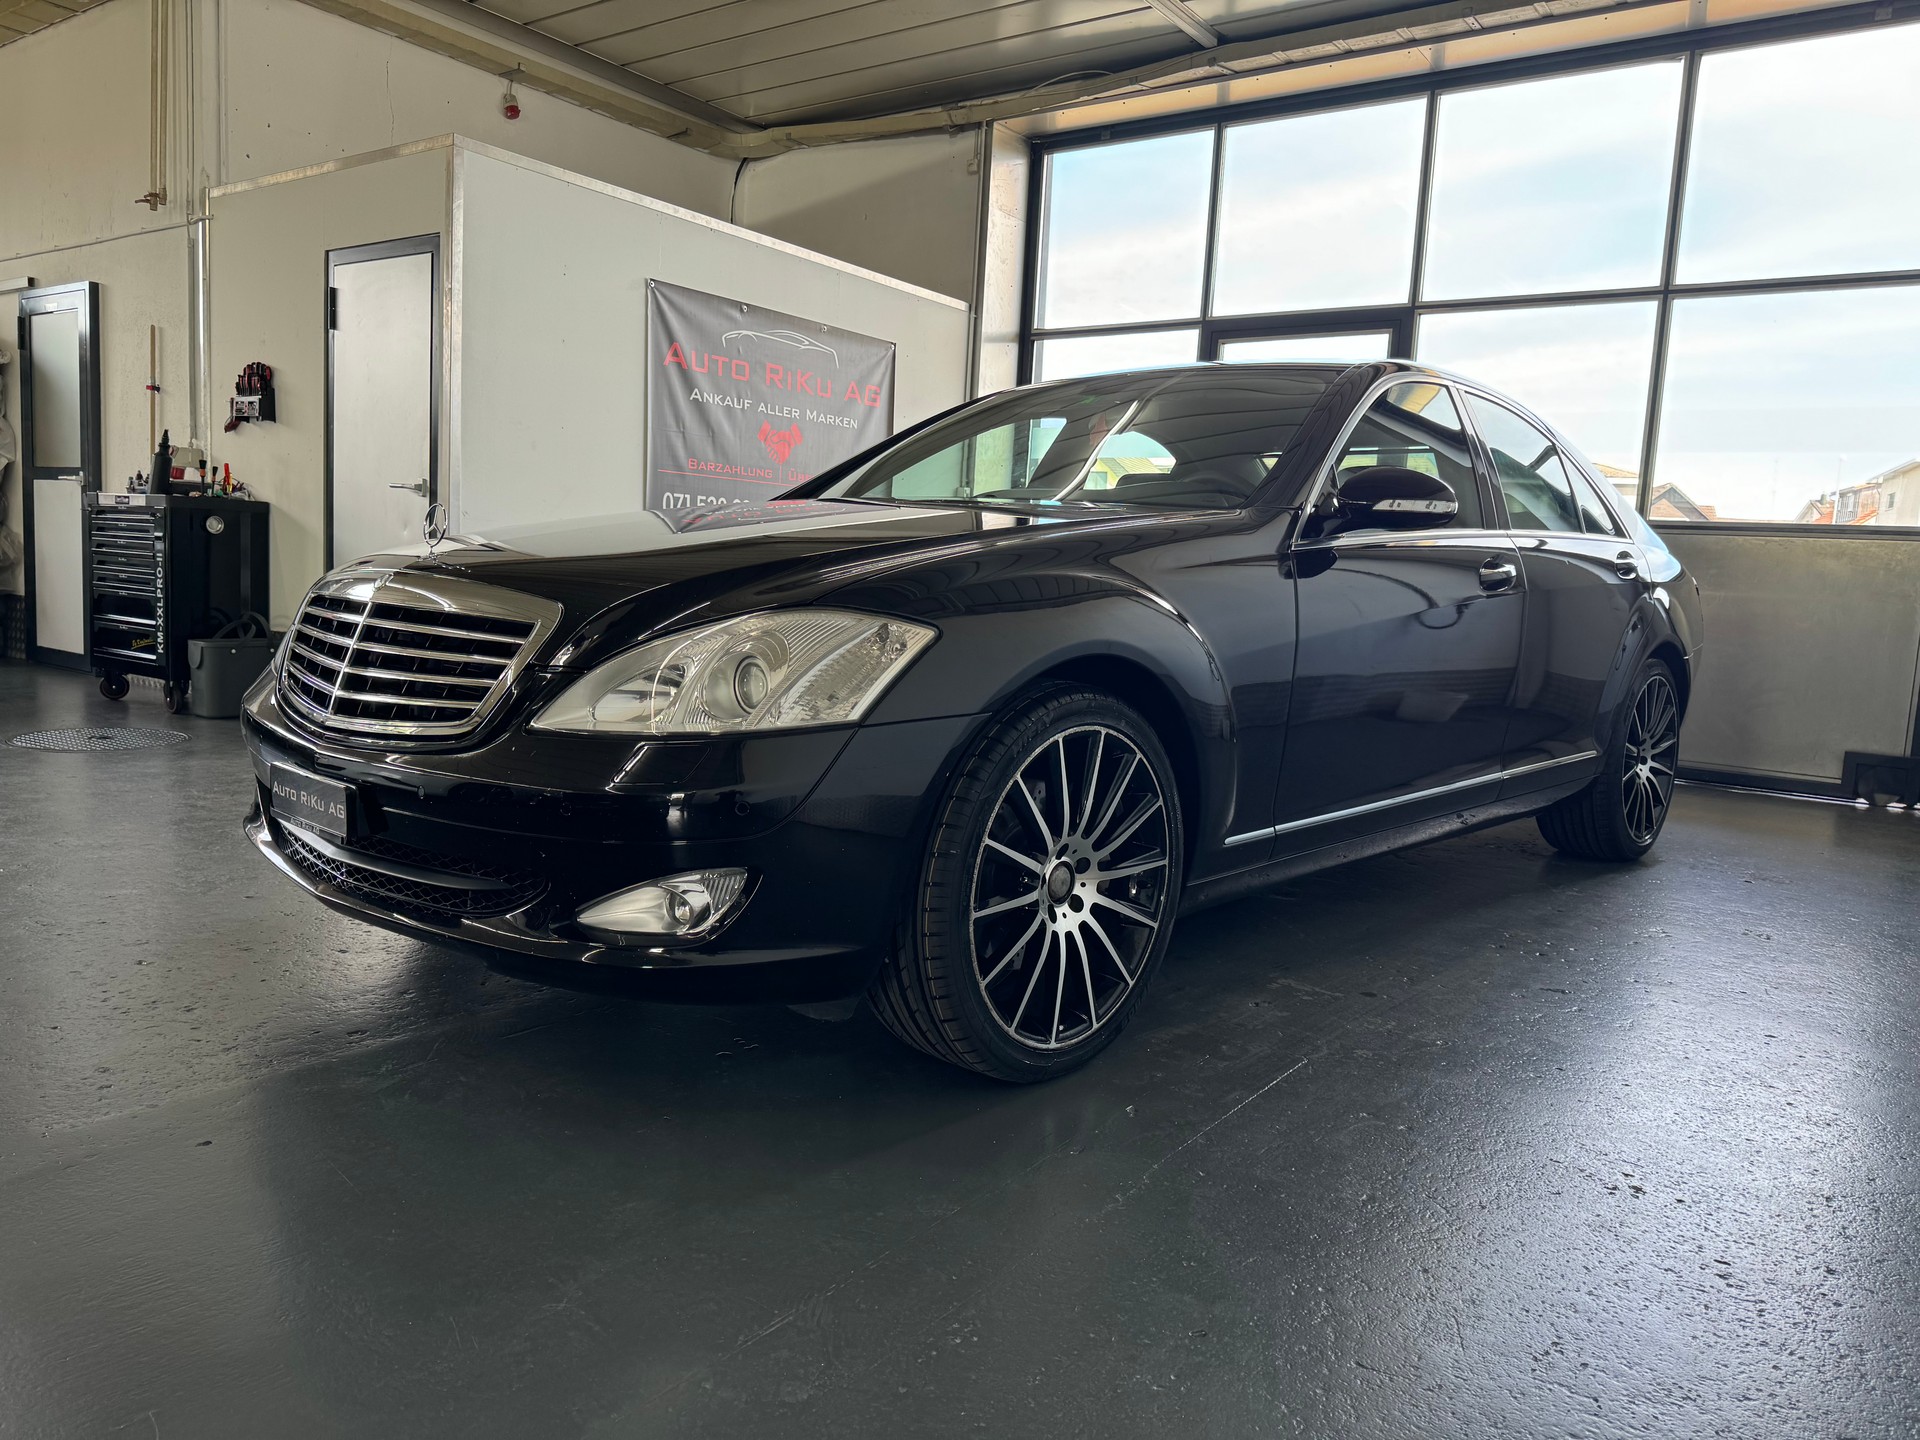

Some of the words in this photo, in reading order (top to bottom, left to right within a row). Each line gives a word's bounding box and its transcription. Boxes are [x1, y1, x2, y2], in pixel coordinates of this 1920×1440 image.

[663, 342, 750, 382] AUTO
[843, 380, 881, 408] AG
[689, 388, 753, 411] ANKAUF
[806, 409, 859, 430] MARKEN
[688, 458, 774, 479] BARZAHLUNG
[272, 780, 297, 801] AUTO
[328, 801, 345, 819] AG
